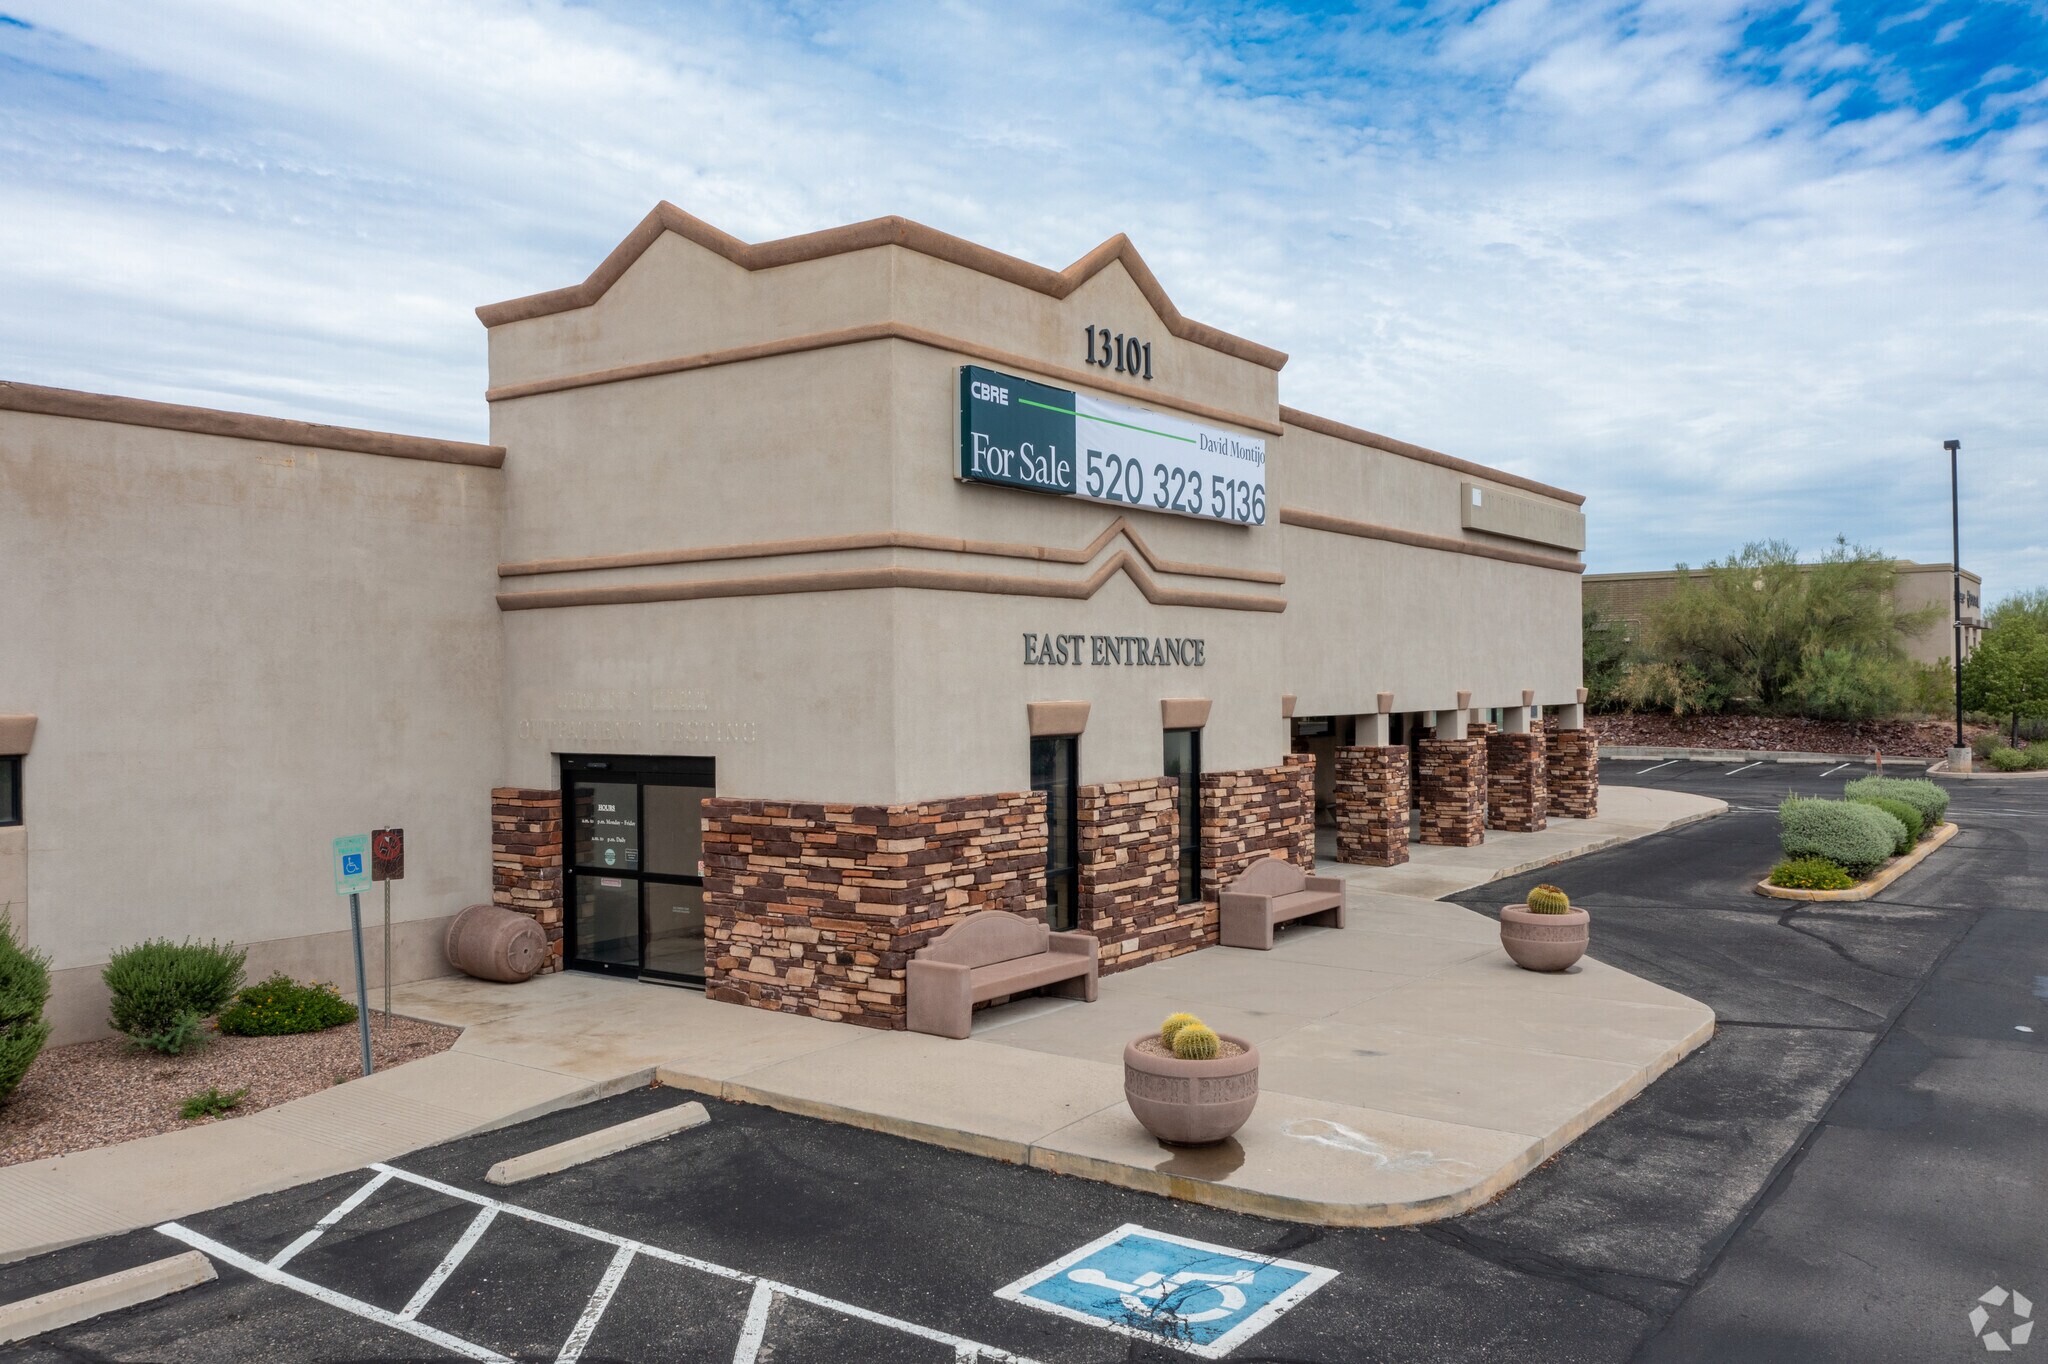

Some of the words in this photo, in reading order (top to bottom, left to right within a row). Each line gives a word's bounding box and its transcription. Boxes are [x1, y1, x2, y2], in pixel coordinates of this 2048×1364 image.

[1085, 324, 1153, 379] 13101
[971, 381, 1009, 406] CBRE
[971, 431, 1015, 478] For
[1019, 441, 1071, 488] Sale
[1200, 432, 1229, 457] David
[1230, 440, 1265, 468] Montijo
[1086, 449, 1144, 504] 520
[1153, 463, 1201, 514] 323
[1211, 475, 1265, 524] 5136
[1022, 632, 1085, 666] EAST
[1091, 635, 1206, 666] ENTRANCE
